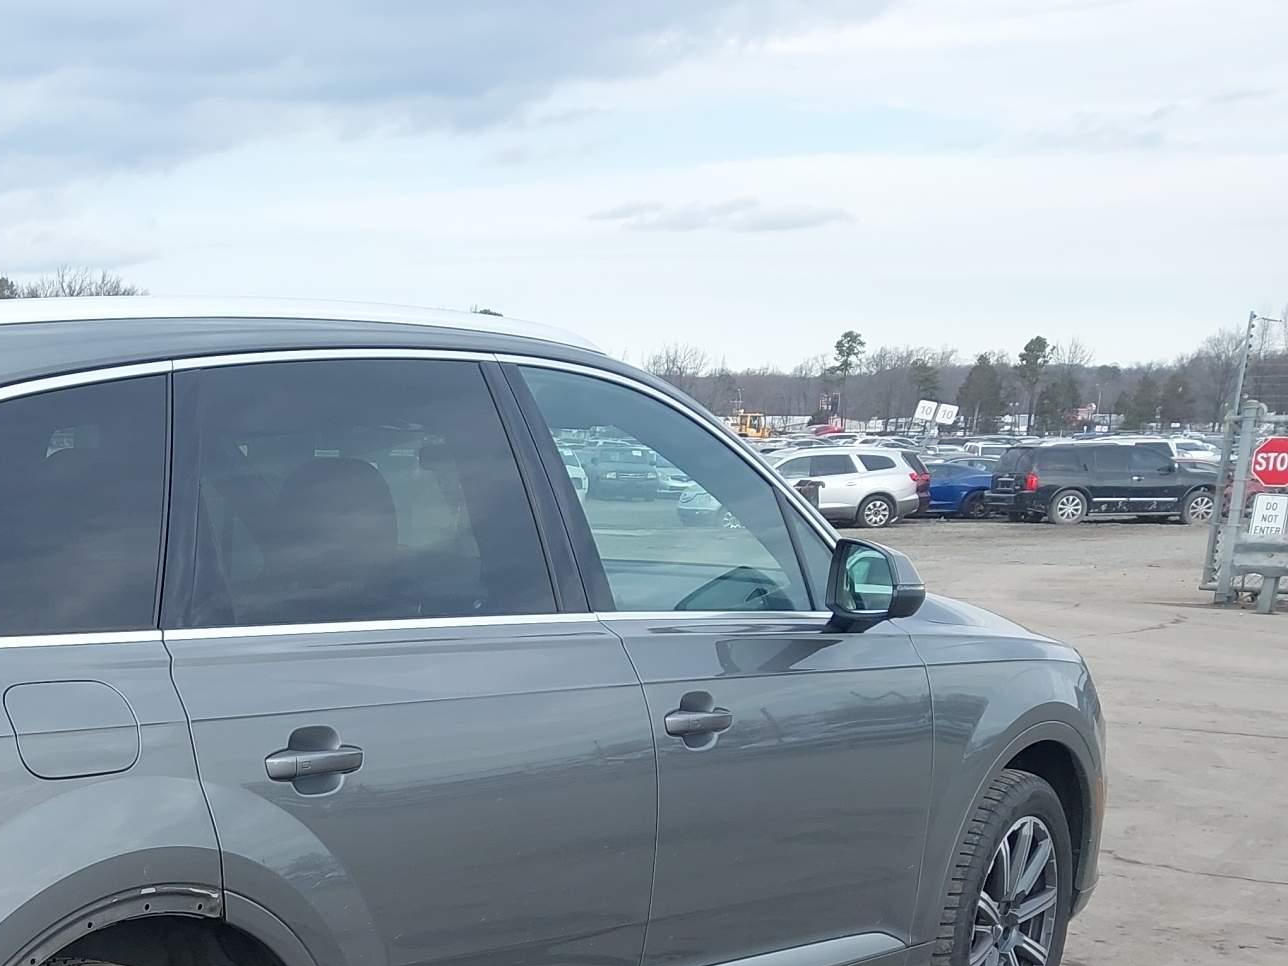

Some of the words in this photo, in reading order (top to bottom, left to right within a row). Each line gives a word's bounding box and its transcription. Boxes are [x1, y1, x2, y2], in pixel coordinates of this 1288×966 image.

[919, 404, 933, 417] 10
[940, 408, 954, 420] 10
[1255, 452, 1288, 472] STO
[1265, 501, 1278, 511] DO
[1260, 513, 1280, 523] NOT
[1253, 525, 1281, 535] ENTER
